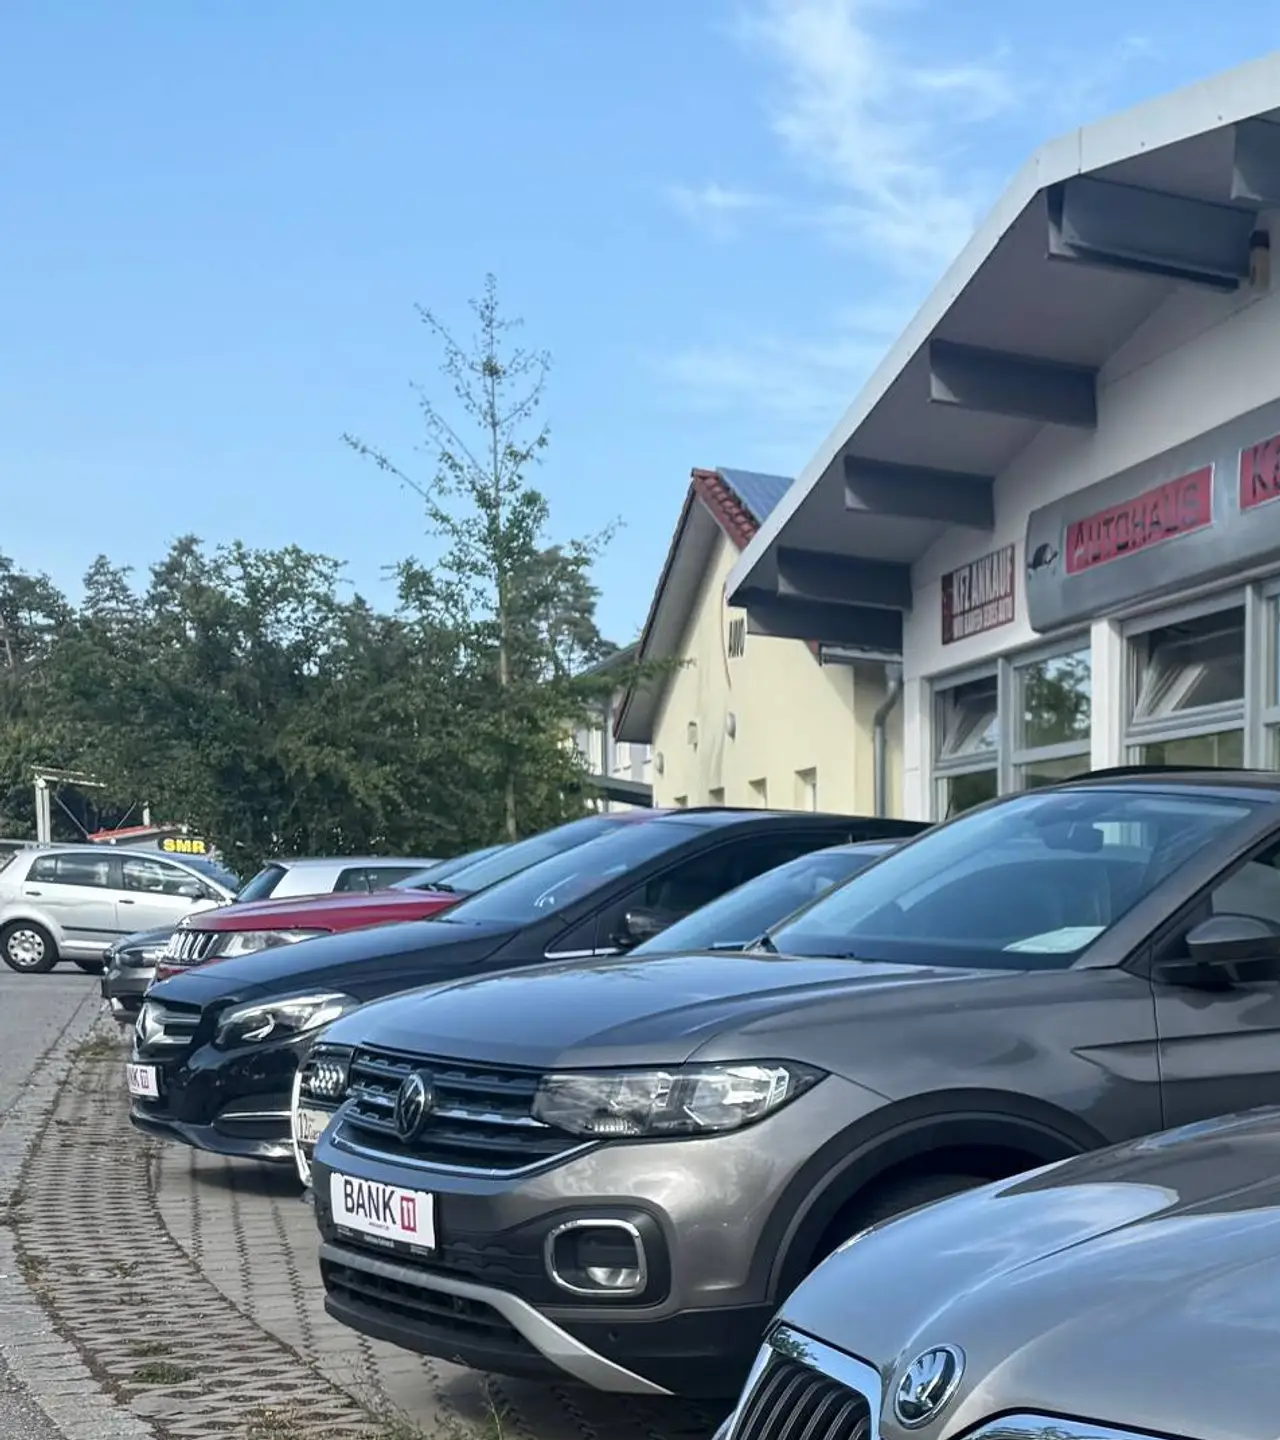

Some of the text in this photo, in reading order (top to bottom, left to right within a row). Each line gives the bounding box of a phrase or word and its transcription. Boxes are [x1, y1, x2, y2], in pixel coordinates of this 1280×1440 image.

[1073, 480, 1201, 569] AUTOHAUS
[162, 837, 207, 854] SMR
[344, 1179, 397, 1225] BANK
